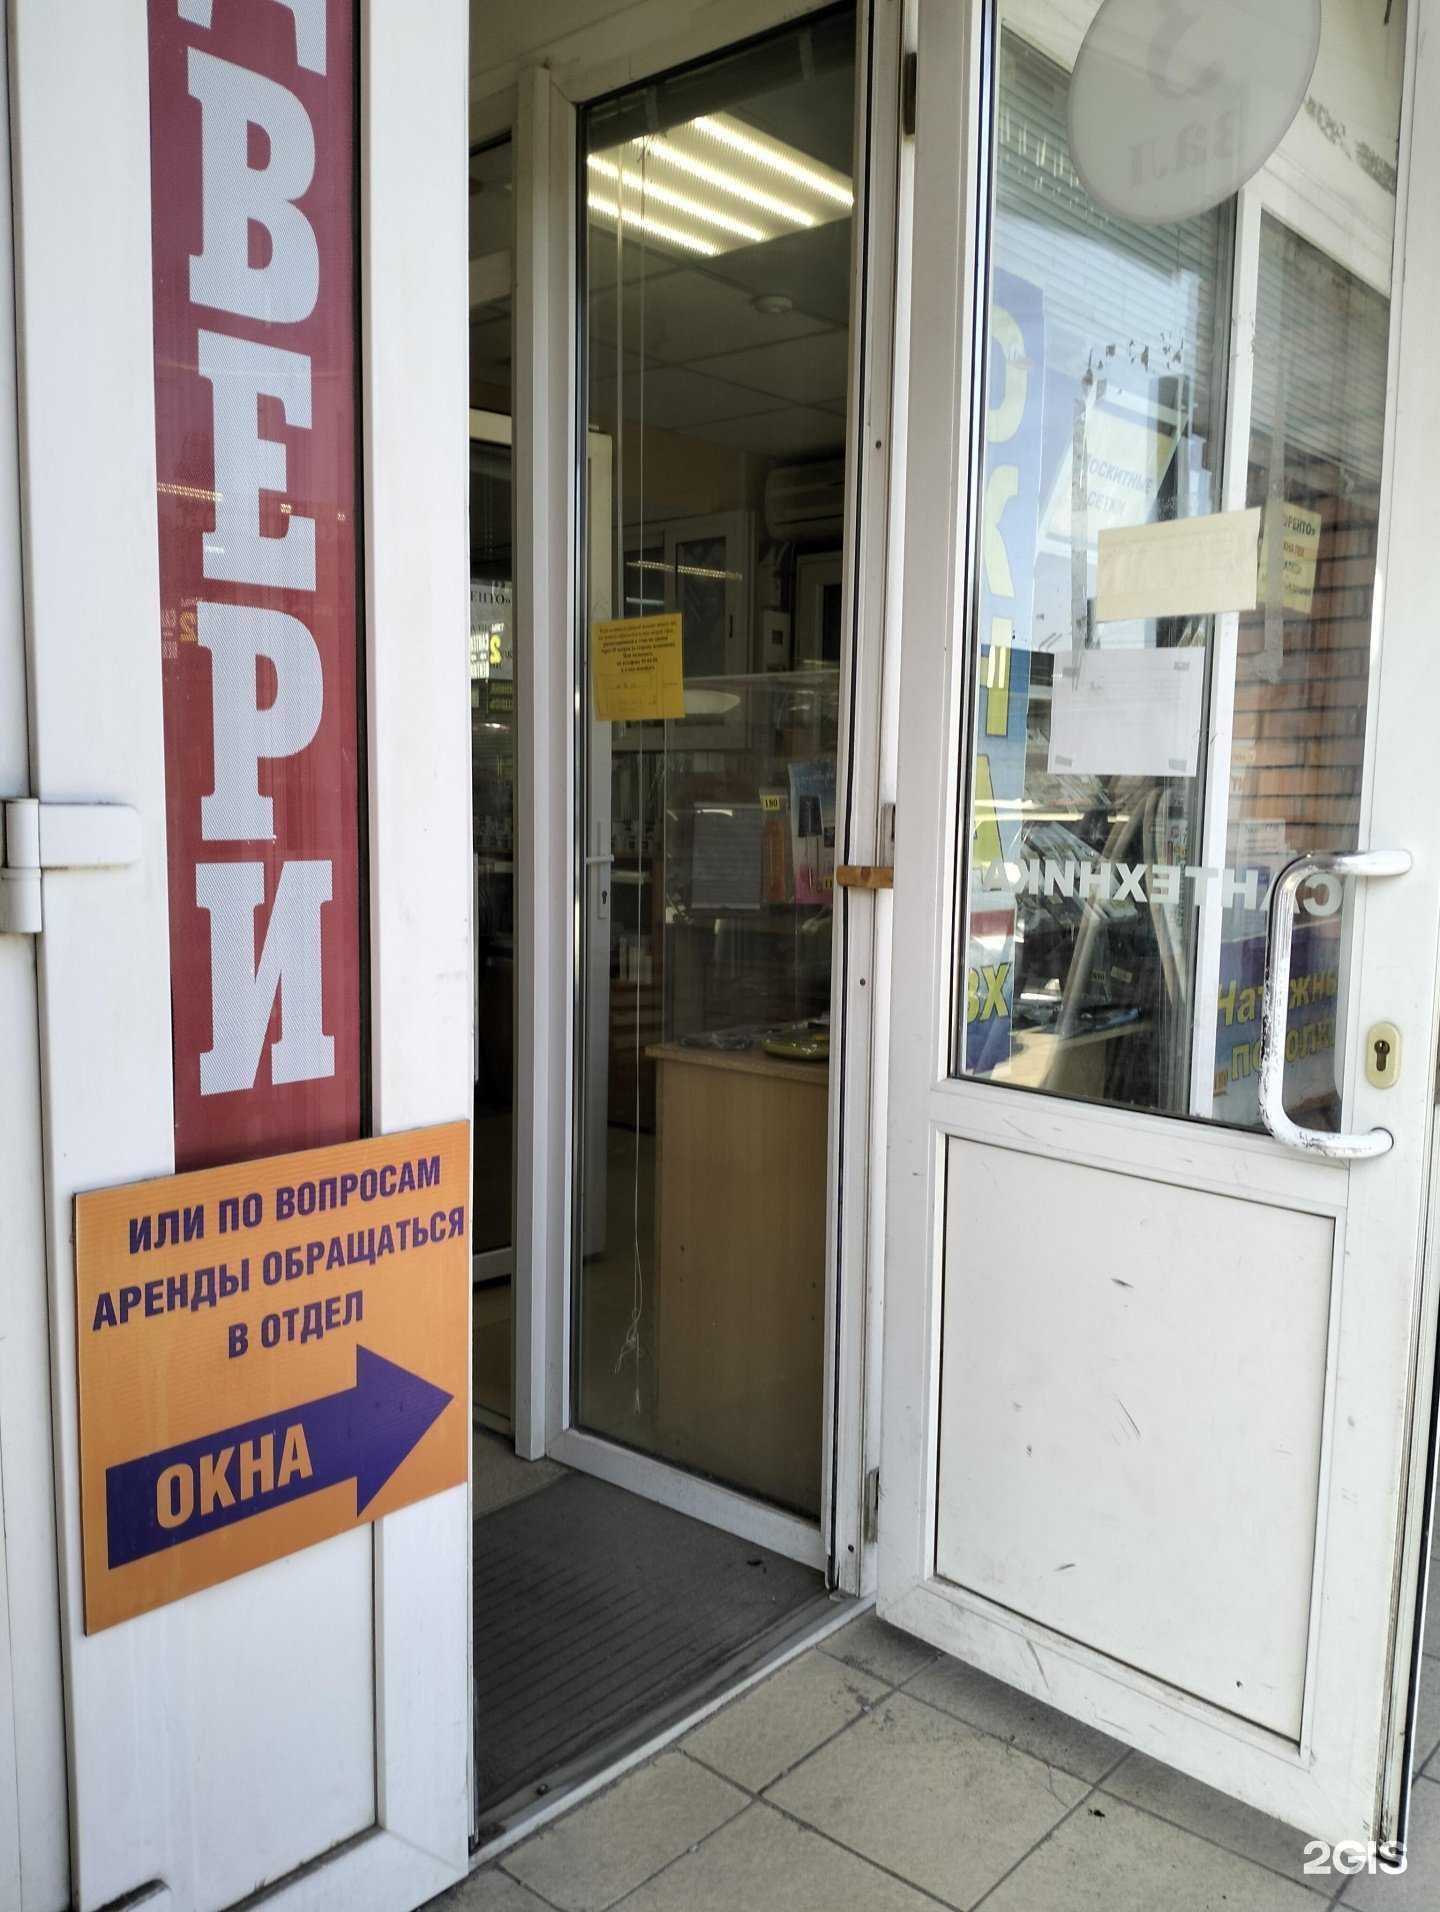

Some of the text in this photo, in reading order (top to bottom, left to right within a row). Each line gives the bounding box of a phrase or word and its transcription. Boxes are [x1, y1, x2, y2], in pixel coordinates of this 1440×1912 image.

[1087, 455, 1153, 491] ОСКИТНЫЕ
[177, 0, 336, 1095] ВЕРИ
[128, 1155, 441, 1255] ИЛИ ПО ВОПРОСАМ
[92, 1205, 466, 1331] АРЕНДЫ ОБРАЩАТЬСЯ
[228, 1289, 364, 1360] В ОТДЕЛ
[155, 1422, 313, 1530] ОКНА
